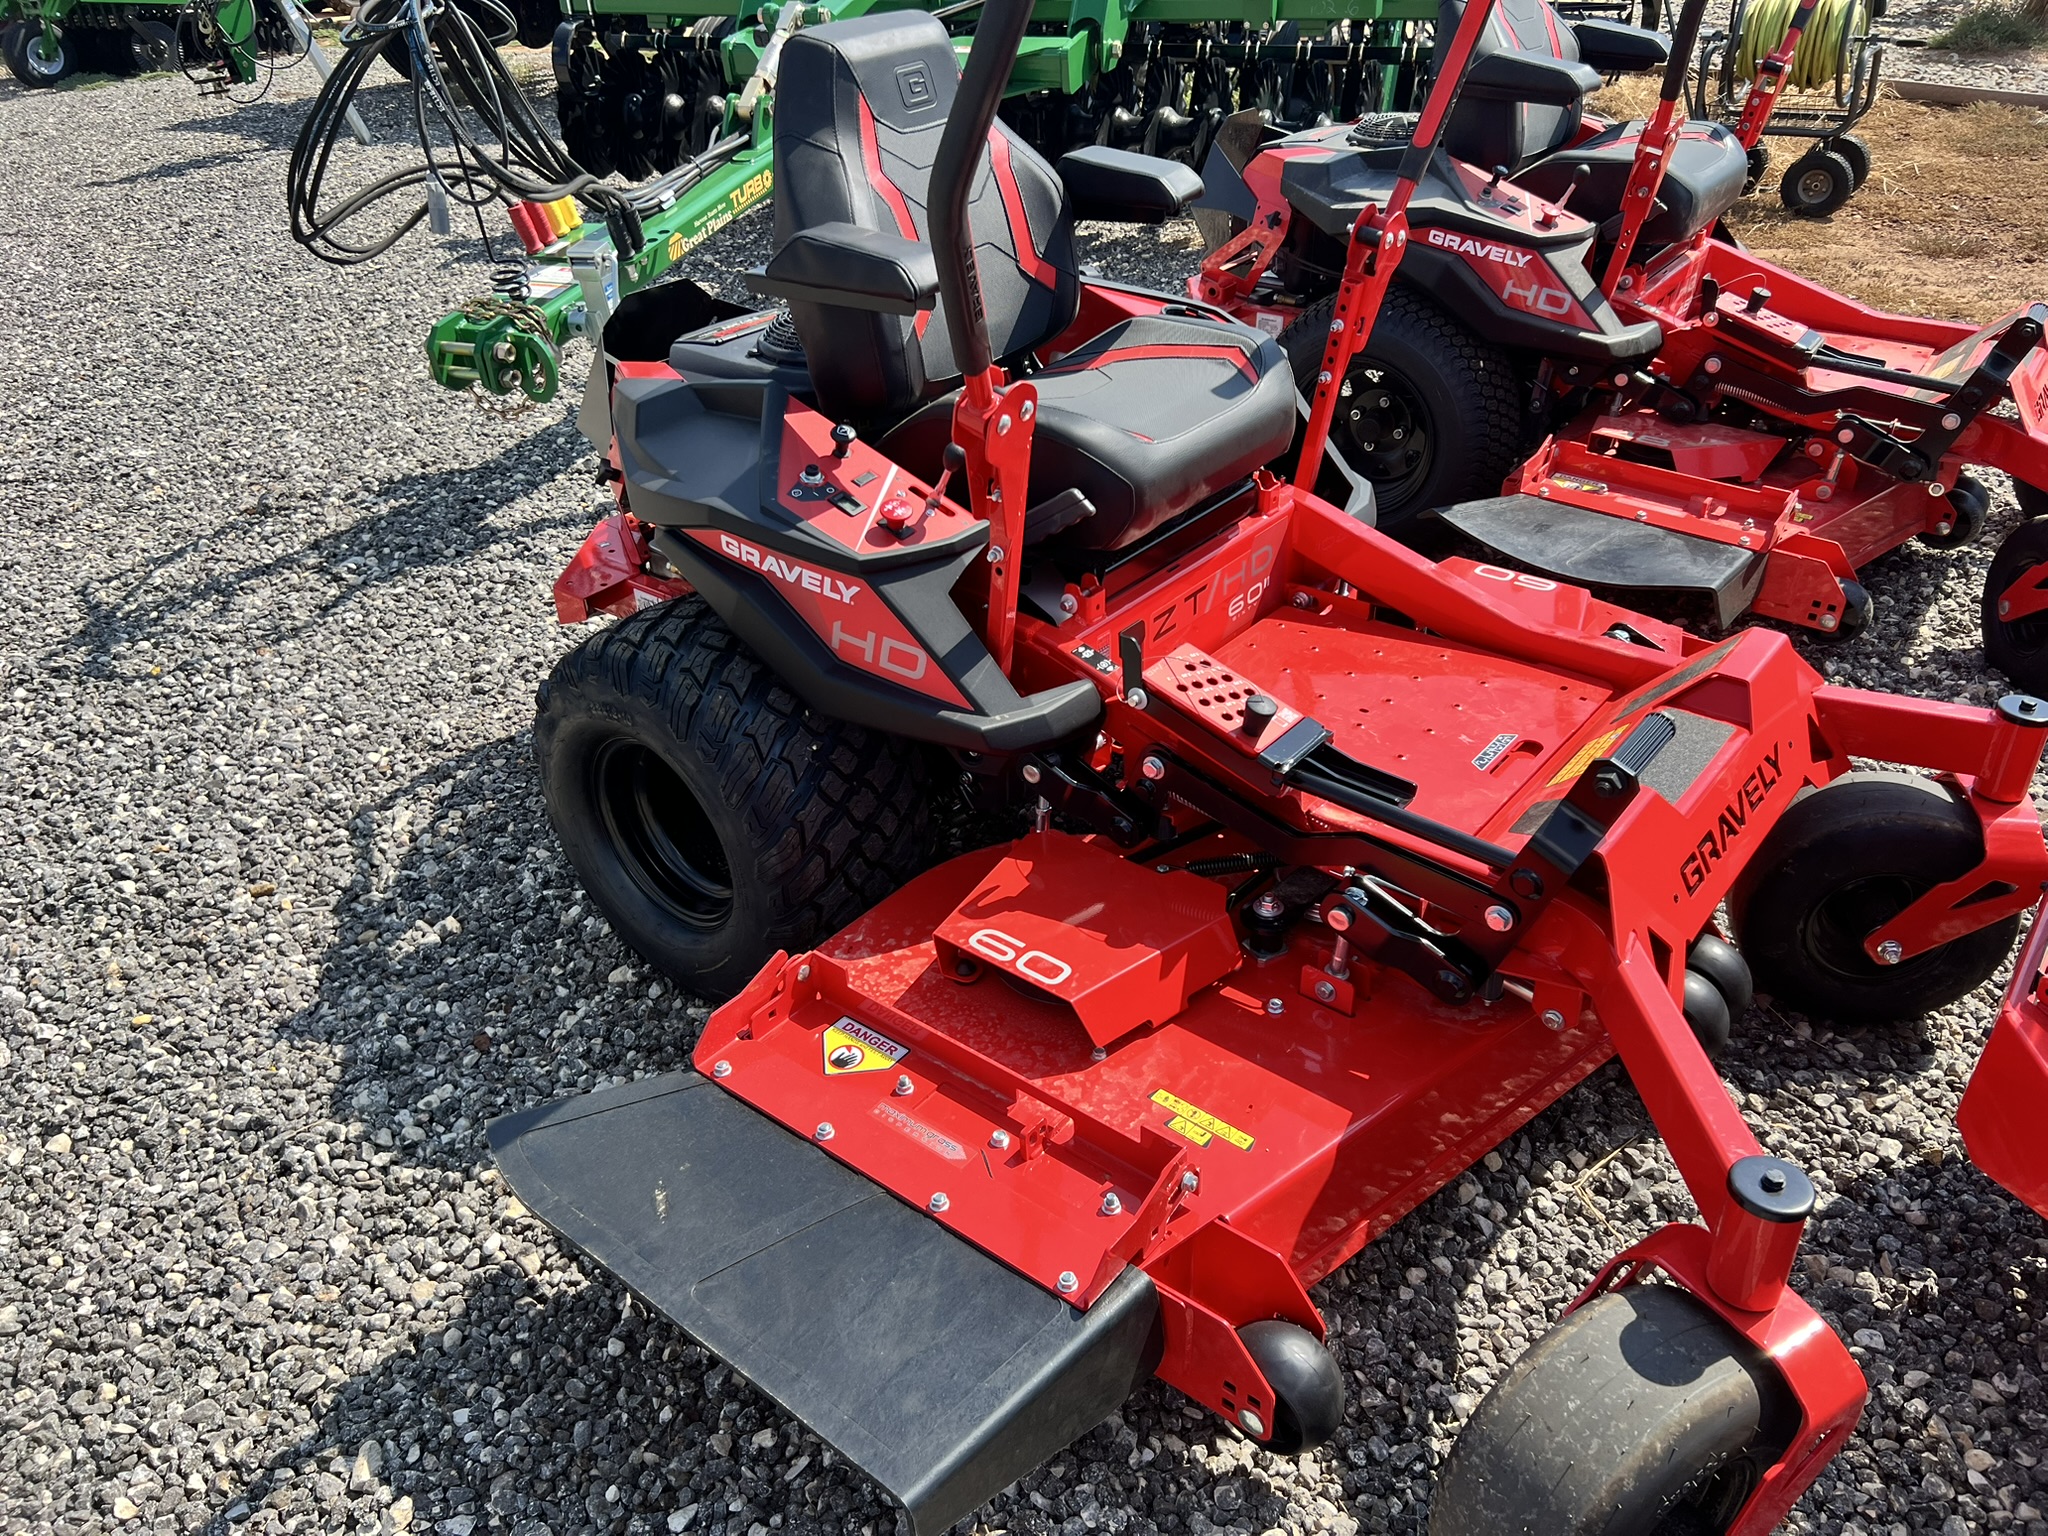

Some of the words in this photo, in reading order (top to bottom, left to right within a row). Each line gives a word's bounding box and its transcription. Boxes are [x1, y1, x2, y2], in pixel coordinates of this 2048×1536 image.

[681, 228, 708, 253] Great
[706, 210, 733, 236] Plains
[1428, 229, 1533, 268] GRAVELY
[1502, 279, 1572, 315] HD
[720, 534, 861, 605] GRAVELY
[831, 620, 927, 680] HD
[1680, 741, 1782, 897] GRAVELY
[968, 928, 1072, 985] 60
[842, 1022, 898, 1055] DANGER
